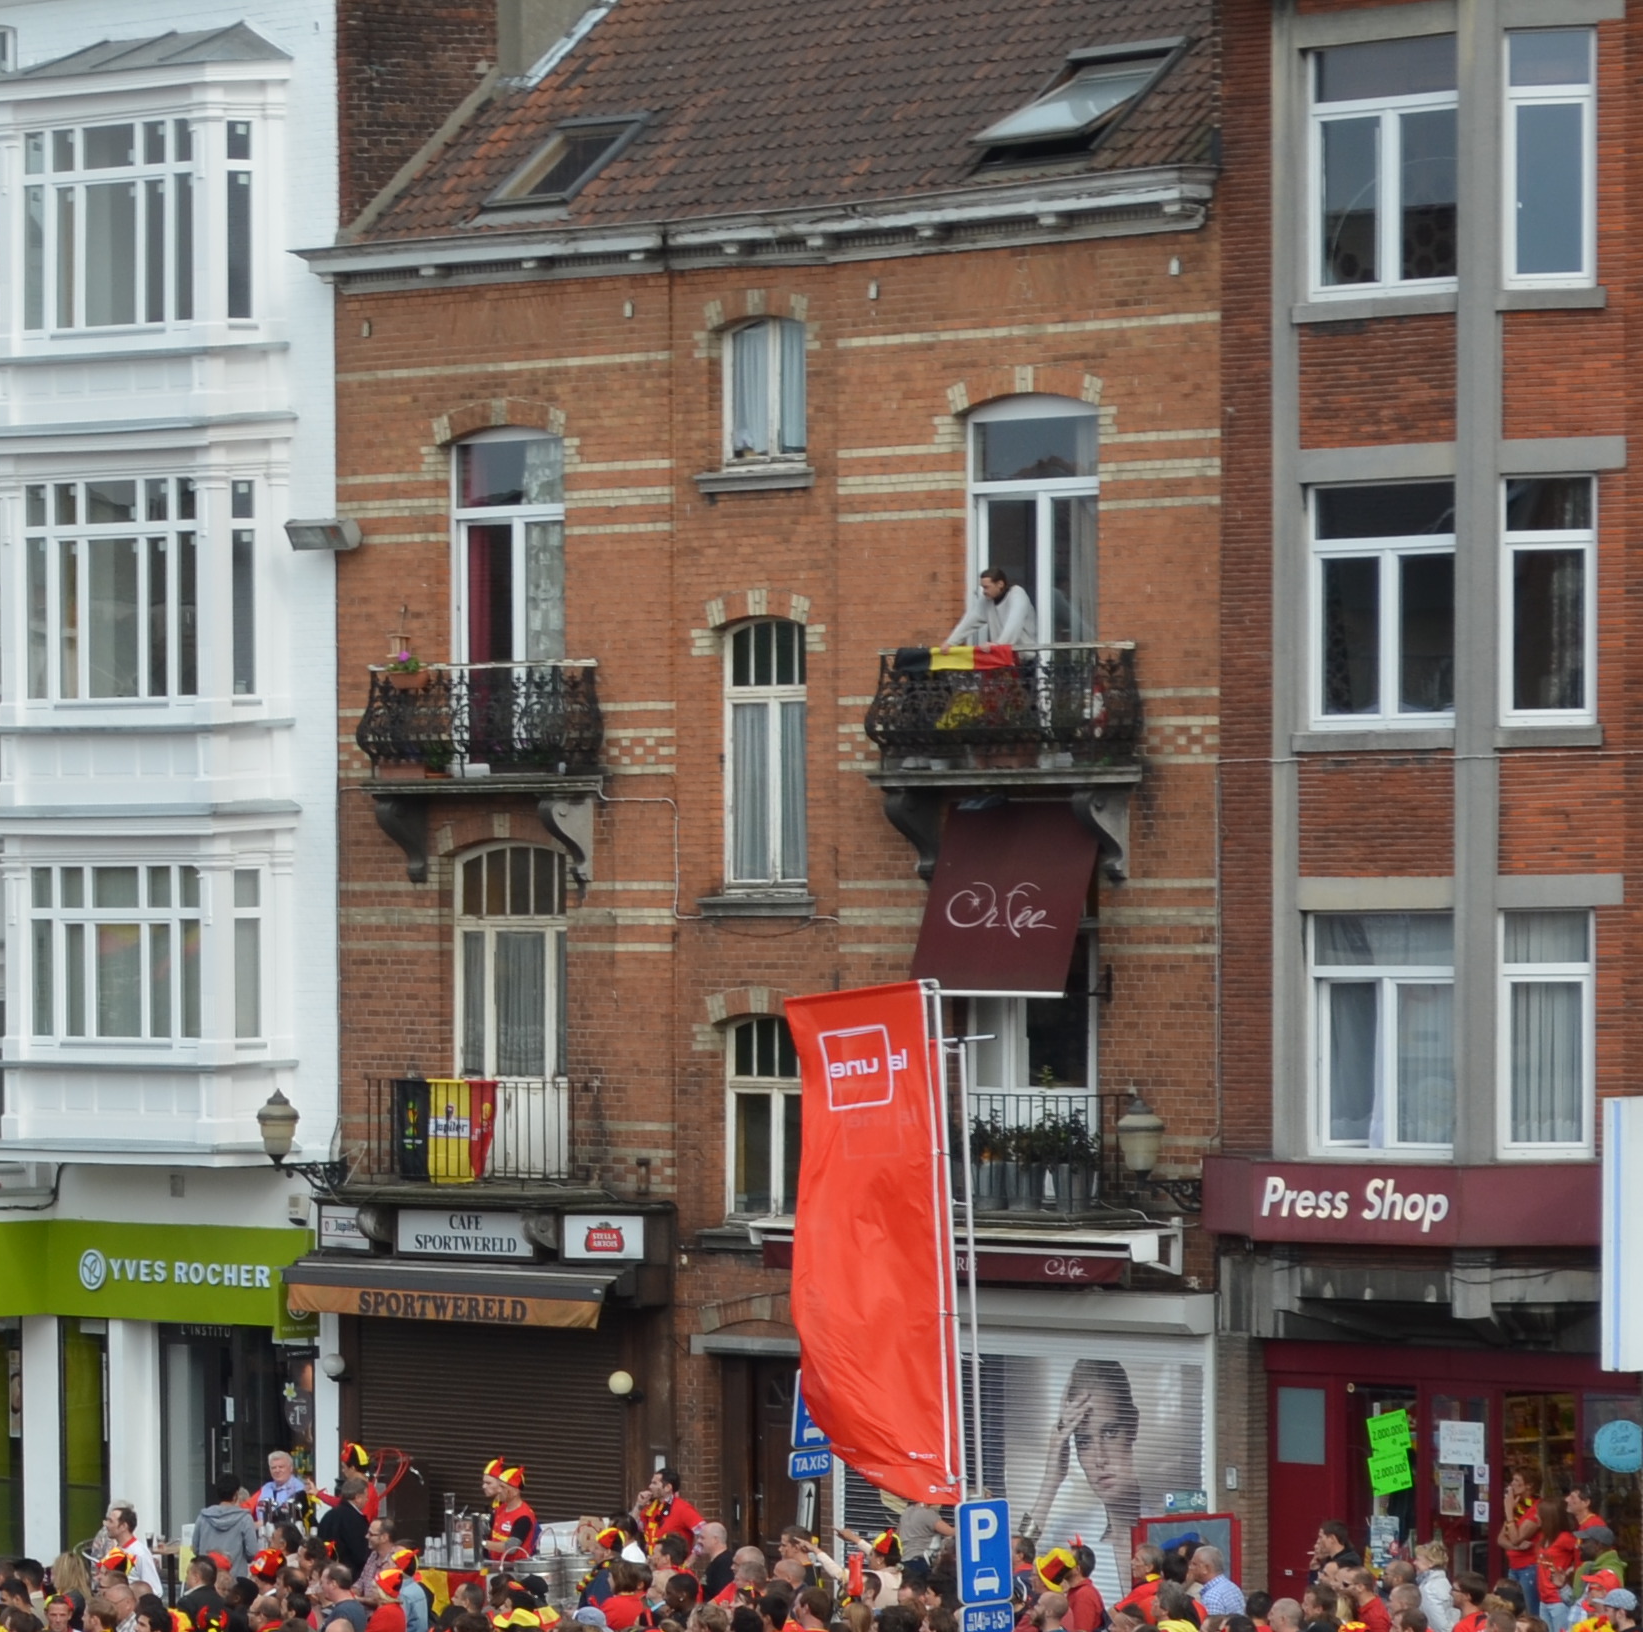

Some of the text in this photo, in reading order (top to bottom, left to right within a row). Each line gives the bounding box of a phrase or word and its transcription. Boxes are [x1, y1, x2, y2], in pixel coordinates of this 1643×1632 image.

[1261, 1176, 1449, 1233] Press Shop
[449, 1214, 482, 1231] CAFE
[414, 1233, 517, 1254] SPORTWERELD
[109, 1257, 271, 1290] YVES ROCHER
[358, 1290, 527, 1324] SPORTWERELD
[796, 1453, 828, 1473] TAXIS
[969, 1508, 998, 1562] P
